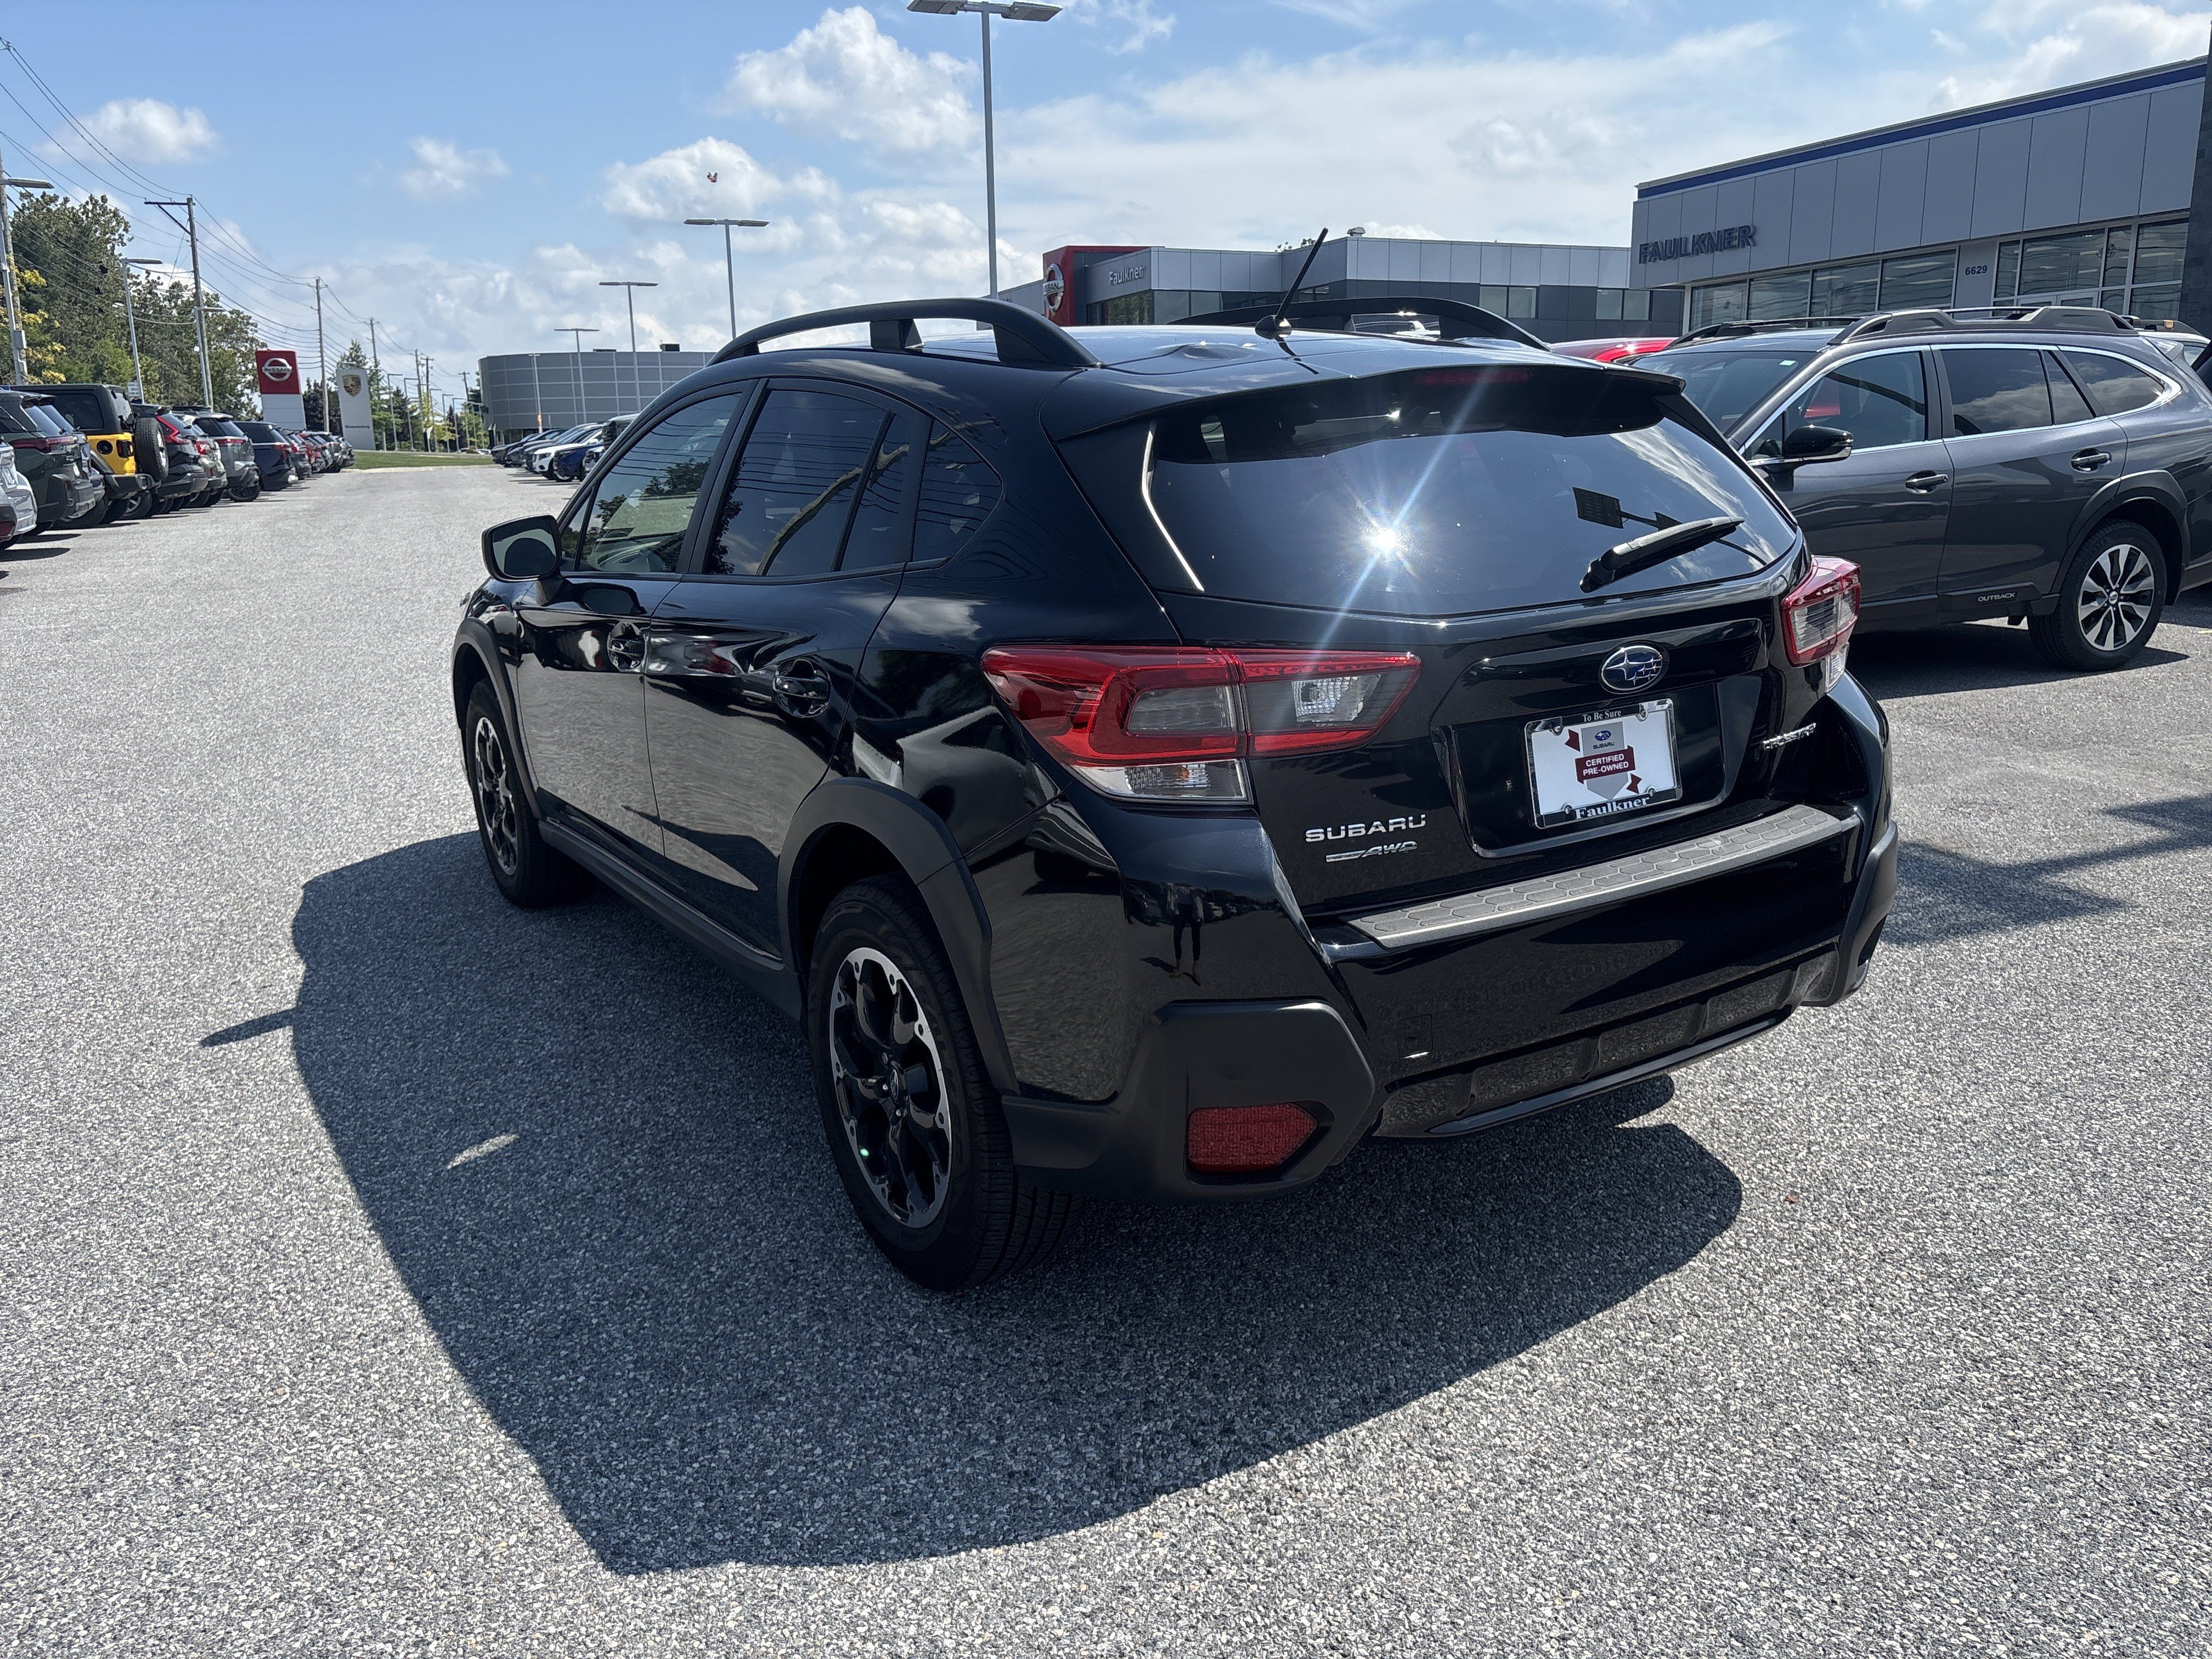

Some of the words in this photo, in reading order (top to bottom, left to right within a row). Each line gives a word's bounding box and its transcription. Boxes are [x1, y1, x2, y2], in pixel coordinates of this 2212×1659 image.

[1639, 225, 1756, 264] FAULKNER
[1109, 266, 1144, 286] Faulkner
[1965, 265, 1988, 275] 6629
[1978, 592, 2016, 602] OUTBACK
[1582, 714, 1592, 722] To
[1594, 712, 1604, 720] Be
[1605, 710, 1622, 719] Sure
[1593, 741, 1615, 749] SUBARU
[1585, 753, 1624, 767] CERTIFIED
[1583, 761, 1629, 776] PRE-OWNED
[1575, 797, 1650, 820] Faulkner
[1305, 814, 1426, 843] SUBARU
[1361, 841, 1418, 858] AWD
